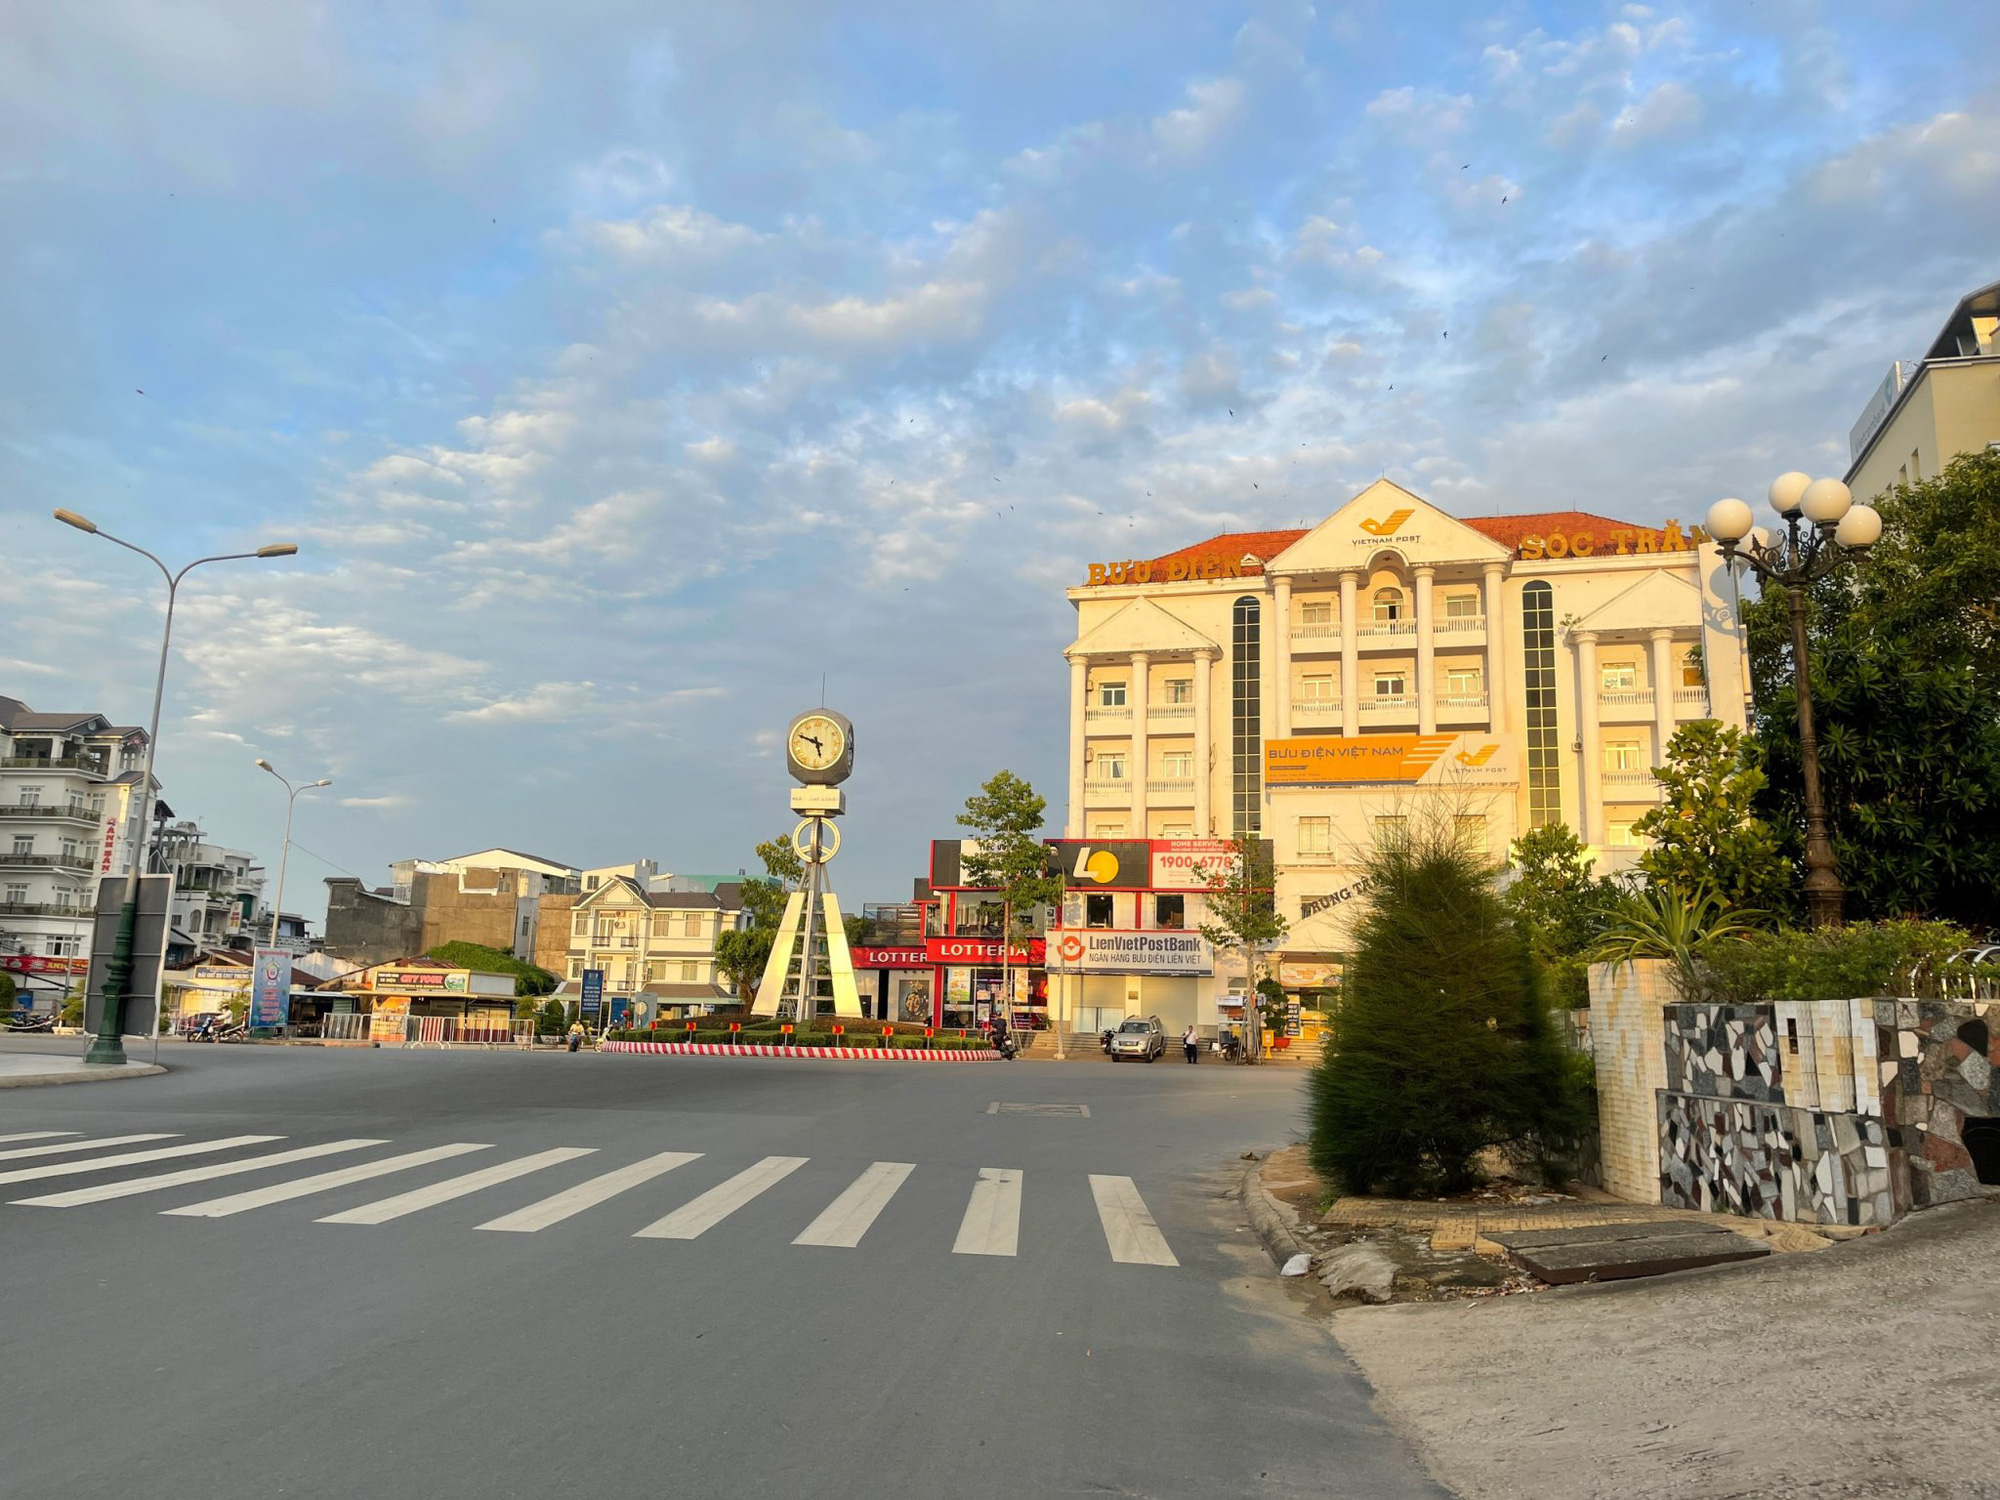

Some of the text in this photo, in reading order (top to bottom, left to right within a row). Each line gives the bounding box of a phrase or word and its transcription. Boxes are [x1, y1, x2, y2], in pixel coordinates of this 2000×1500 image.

[1352, 534, 1421, 546] VIETNAM POST
[1520, 526, 1594, 560] SÓC
[1088, 552, 1242, 586] BƯU ĐIỆN
[1268, 745, 1404, 760] BƯU ĐIỆN VIỆT NAM
[1160, 855, 1233, 869] 1900 6778
[941, 944, 1028, 957] LOTTERIA
[1132, 953, 1147, 963] BƯU
